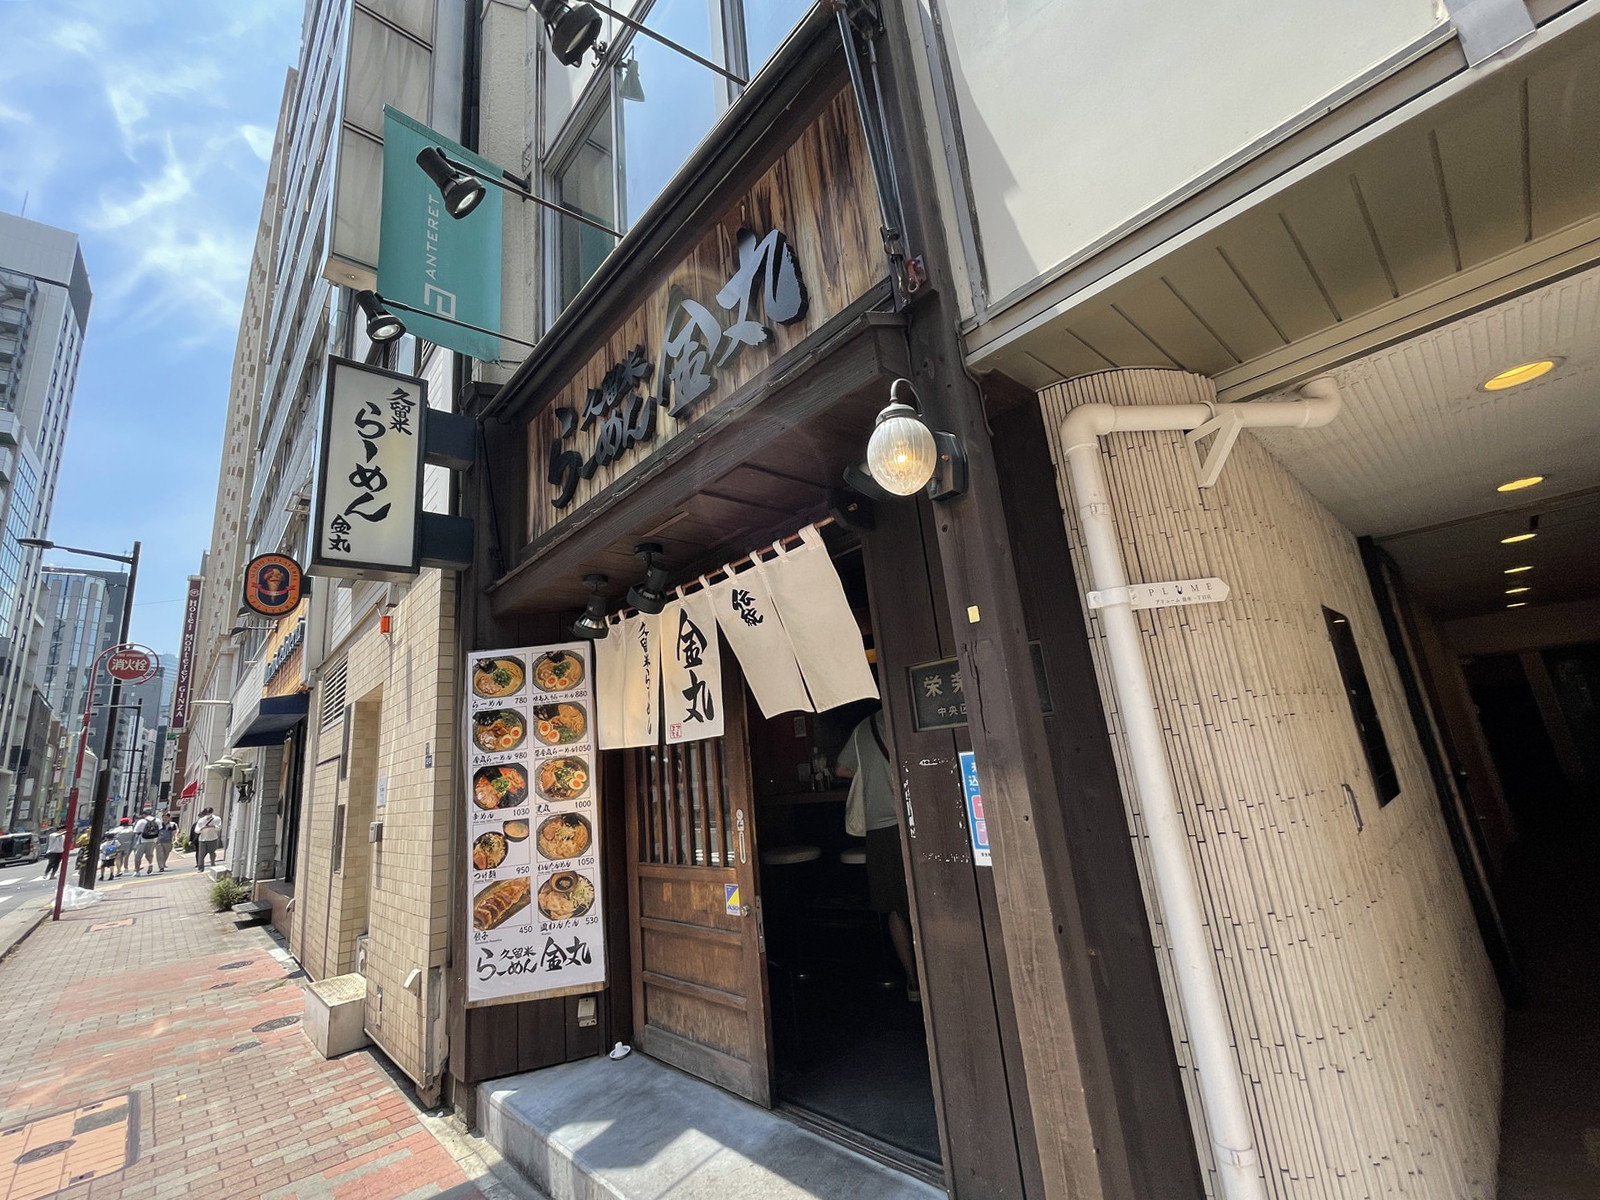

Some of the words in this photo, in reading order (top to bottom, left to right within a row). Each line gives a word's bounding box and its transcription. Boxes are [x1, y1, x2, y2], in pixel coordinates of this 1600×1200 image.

[547, 393, 658, 510] らーめん
[656, 227, 811, 419] 金丸
[386, 386, 417, 436] 久留米
[343, 400, 392, 523] らーめん
[328, 513, 352, 553] 金丸
[111, 658, 148, 671] 消火栓
[676, 607, 715, 724] 金丸
[575, 745, 592, 753] 1050
[514, 752, 528, 760] 980
[575, 800, 592, 808] 1000
[513, 808, 530, 817] 1030
[577, 858, 595, 866] 1050
[516, 866, 530, 875] 950
[585, 916, 599, 925] 530
[519, 926, 533, 934] 450
[476, 947, 538, 982] らーめん
[540, 935, 593, 973] 金丸
[500, 945, 537, 961] 久留米
